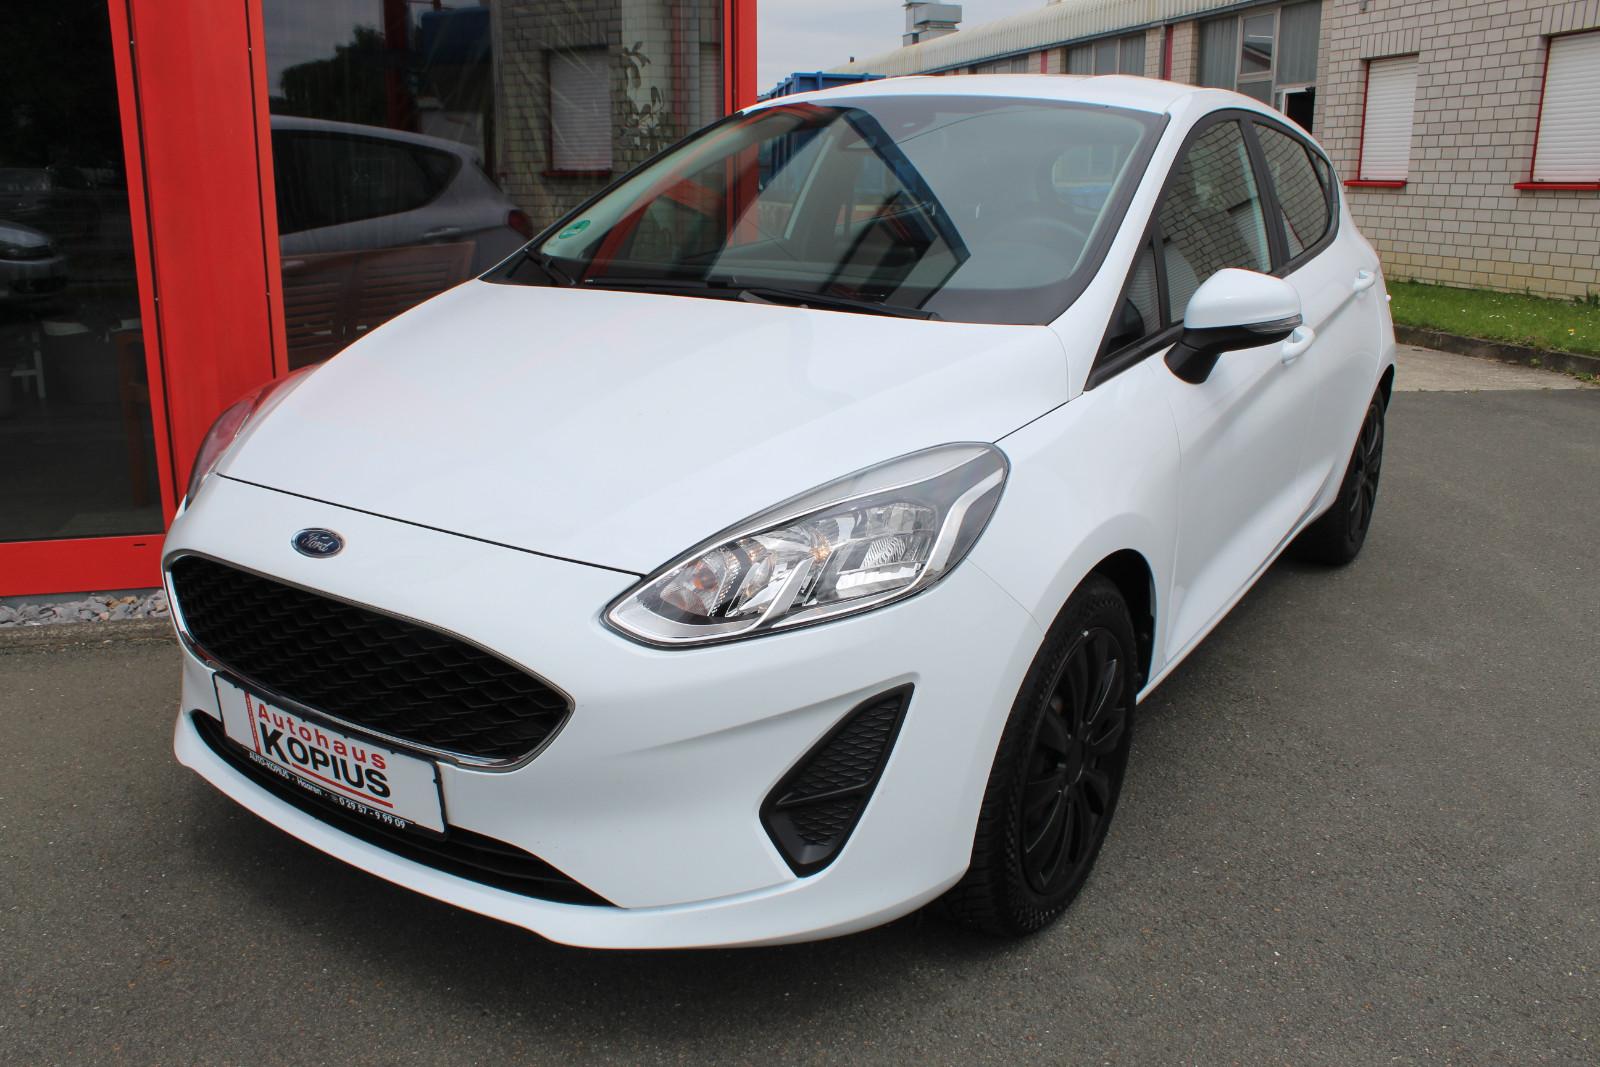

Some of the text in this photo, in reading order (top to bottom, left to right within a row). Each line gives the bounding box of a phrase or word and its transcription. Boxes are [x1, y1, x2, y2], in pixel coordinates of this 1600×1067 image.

[301, 533, 334, 552] Ford
[258, 703, 386, 769] Autohaus
[260, 722, 391, 798] KOPIUS
